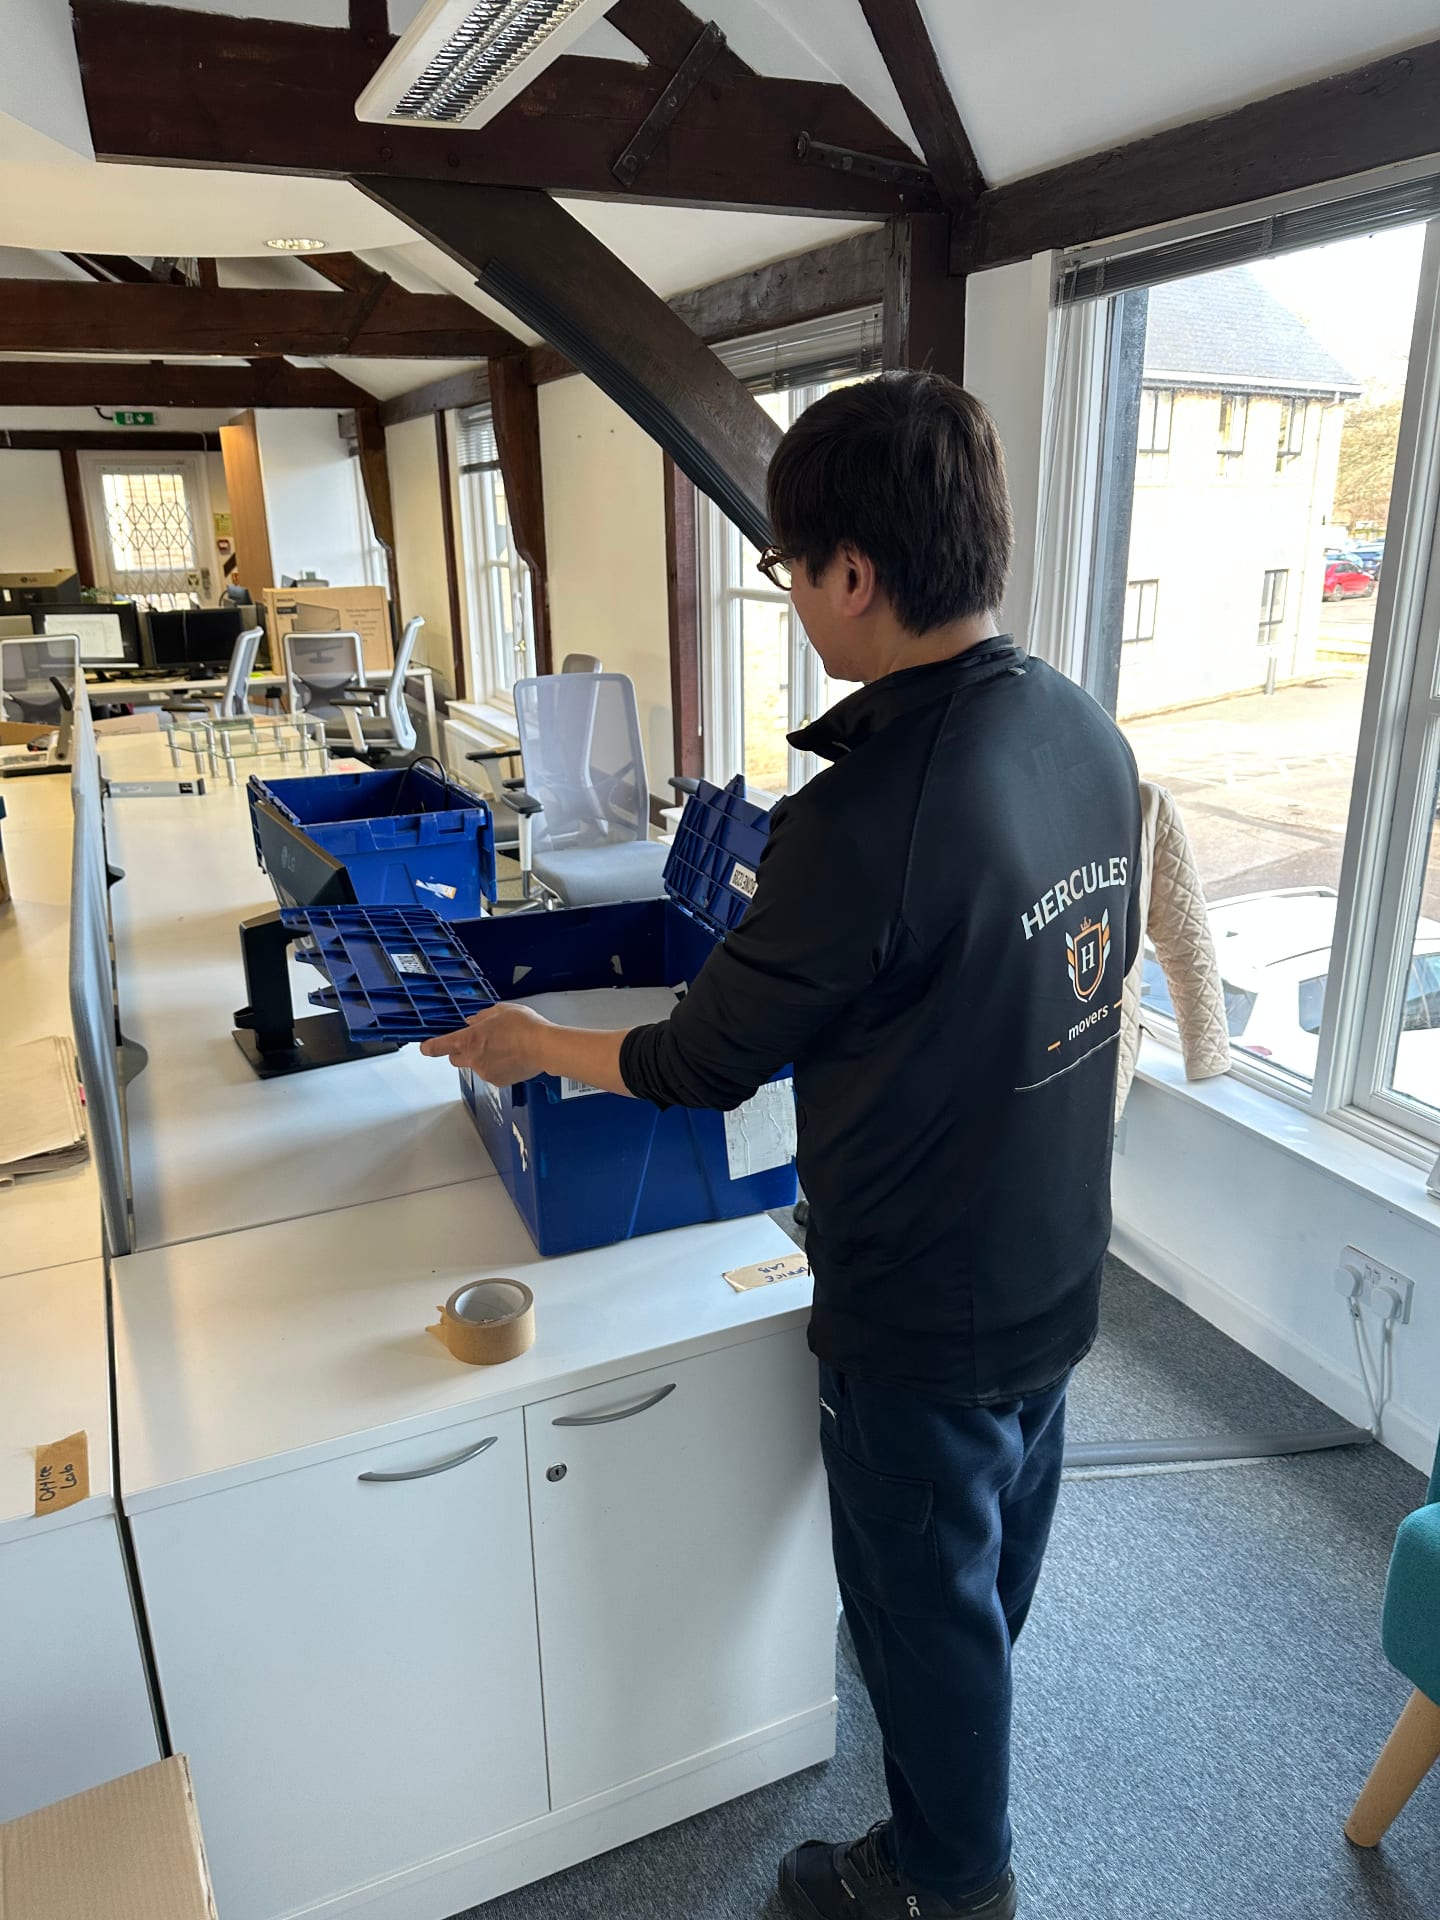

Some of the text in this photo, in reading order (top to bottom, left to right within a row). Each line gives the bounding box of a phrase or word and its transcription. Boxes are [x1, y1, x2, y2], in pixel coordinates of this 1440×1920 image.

[1020, 856, 1128, 941] HERCULES
[1080, 940, 1096, 975] H
[1068, 1003, 1109, 1041] movers
